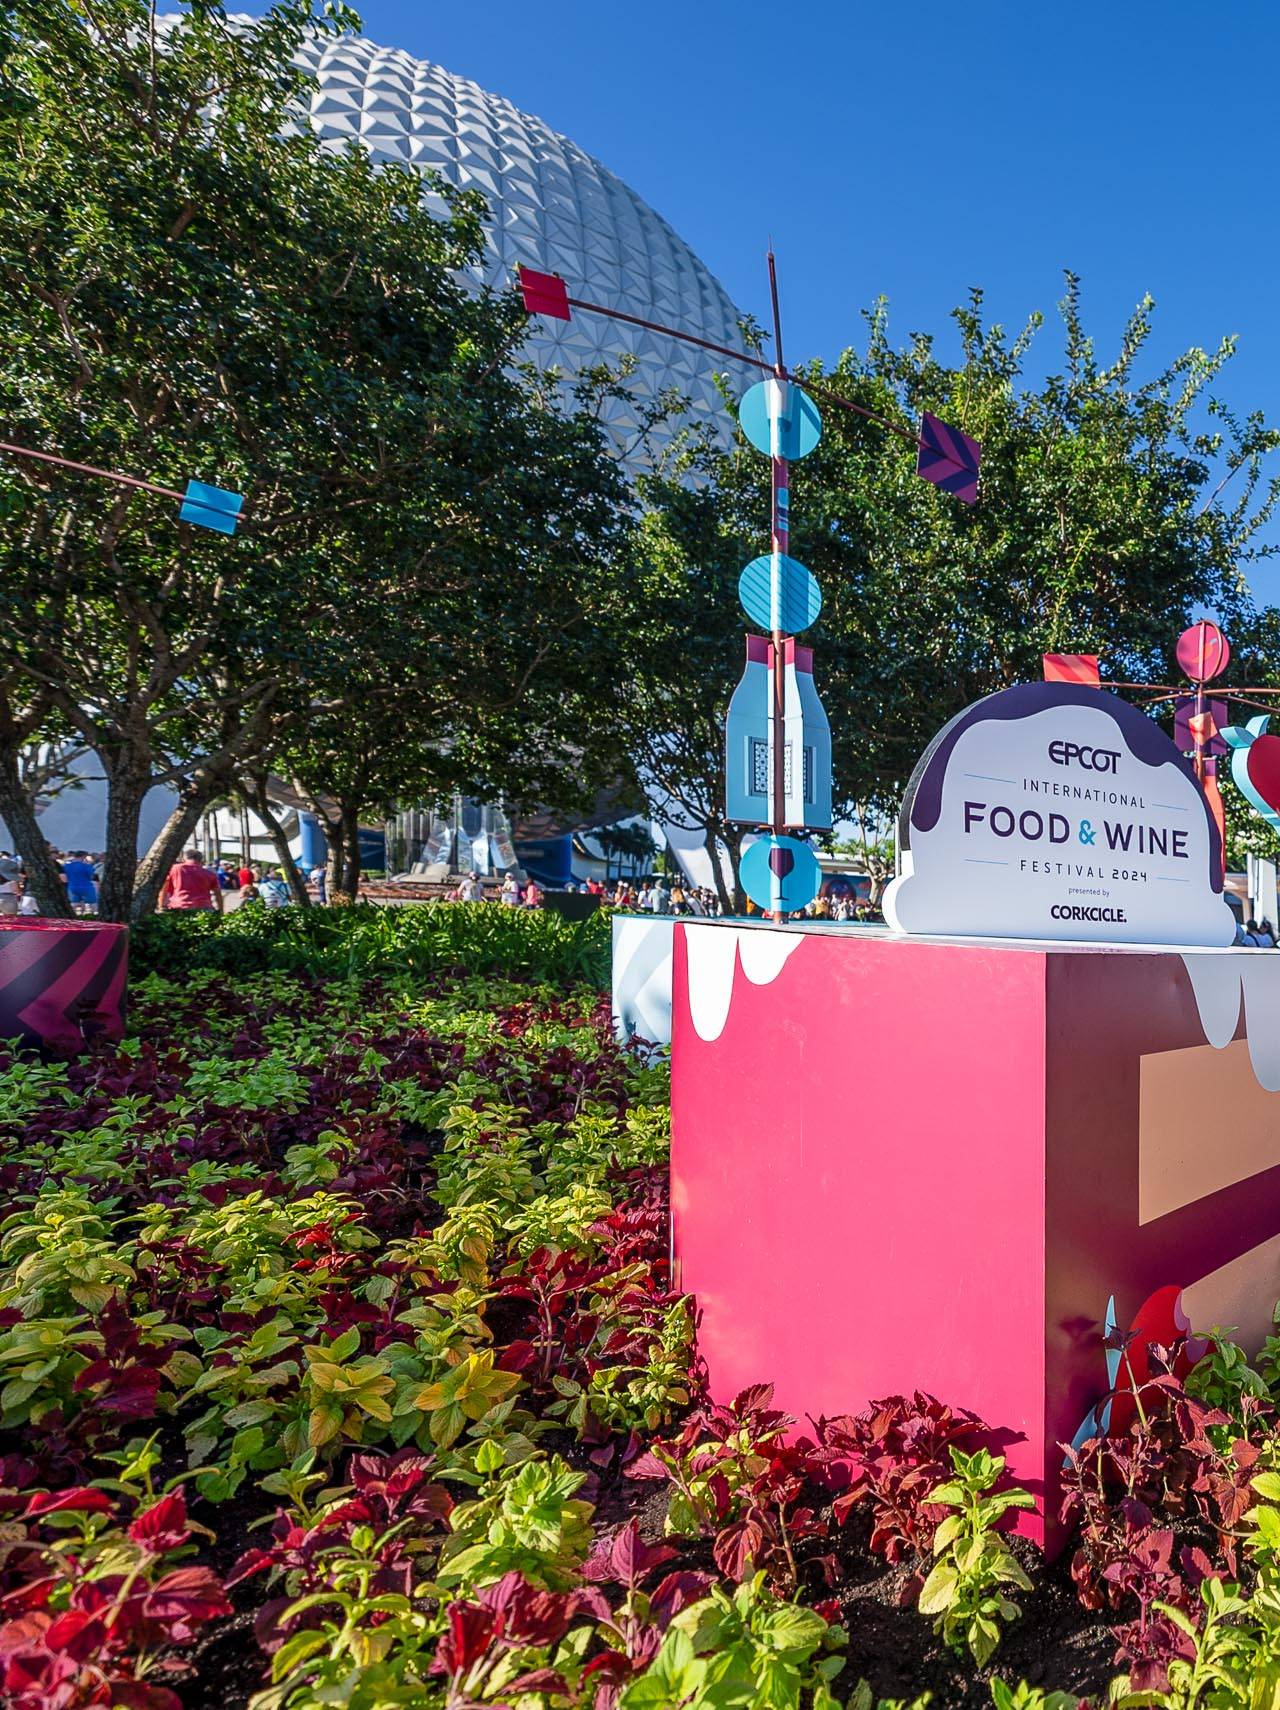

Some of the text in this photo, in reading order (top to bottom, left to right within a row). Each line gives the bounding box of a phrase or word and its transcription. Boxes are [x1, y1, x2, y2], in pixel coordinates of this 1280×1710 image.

[1048, 740, 1121, 775] EPCOT
[1023, 778, 1146, 809] INTERNATIONAL
[964, 801, 1190, 859] FOOD & WINE
[1020, 860, 1148, 882] FESTIVAL 2024
[1068, 887, 1111, 898] presented by
[1050, 904, 1128, 923] CORKCICLE.
